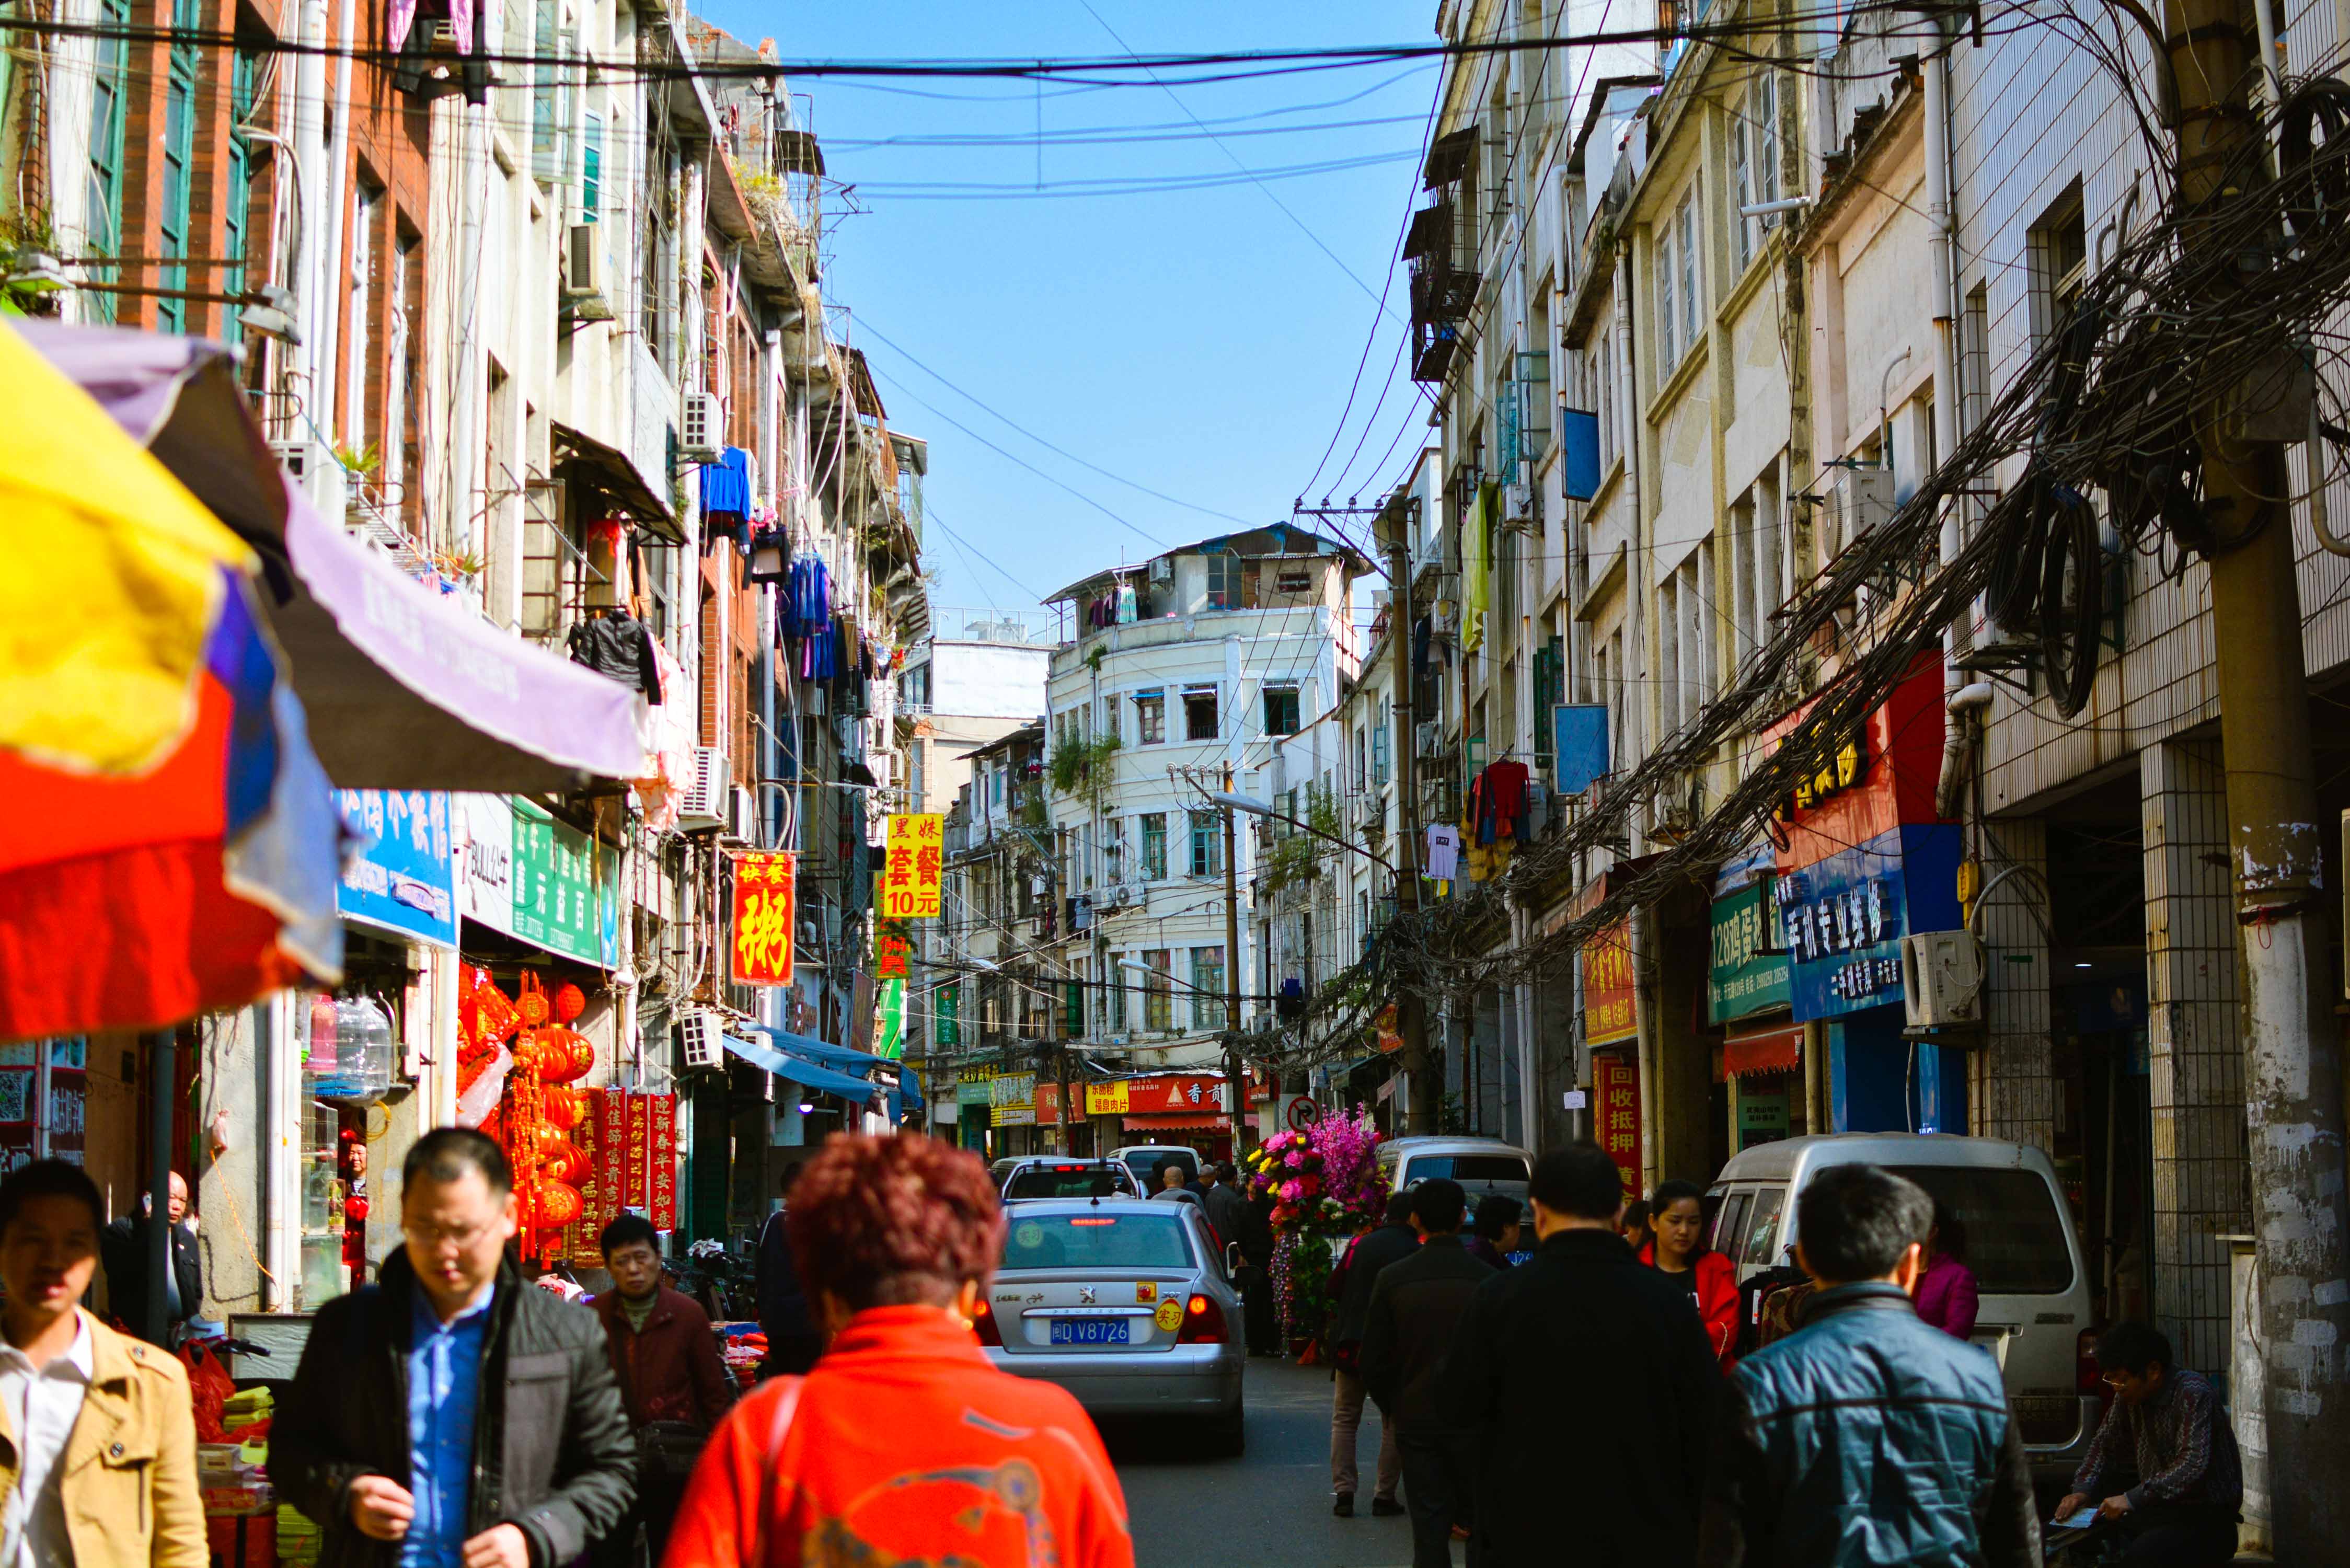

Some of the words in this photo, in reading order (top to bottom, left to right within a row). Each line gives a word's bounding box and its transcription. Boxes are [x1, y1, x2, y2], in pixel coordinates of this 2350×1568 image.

[892, 817, 941, 839] 黑妹
[740, 864, 790, 884] 快餐
[889, 845, 940, 886] 套餐
[888, 891, 938, 914] 10元
[738, 888, 788, 977] 粥
[1788, 878, 1882, 964] 手机专业维修
[1095, 1098, 1128, 1112] 福鼎肉片
[1609, 1067, 1635, 1152] 回收抵押
[654, 1097, 672, 1228] 迎新春平安如意
[1158, 1308, 1181, 1325] 实习
[1052, 1323, 1072, 1340] 闽D
[1077, 1323, 1127, 1340] V8726
